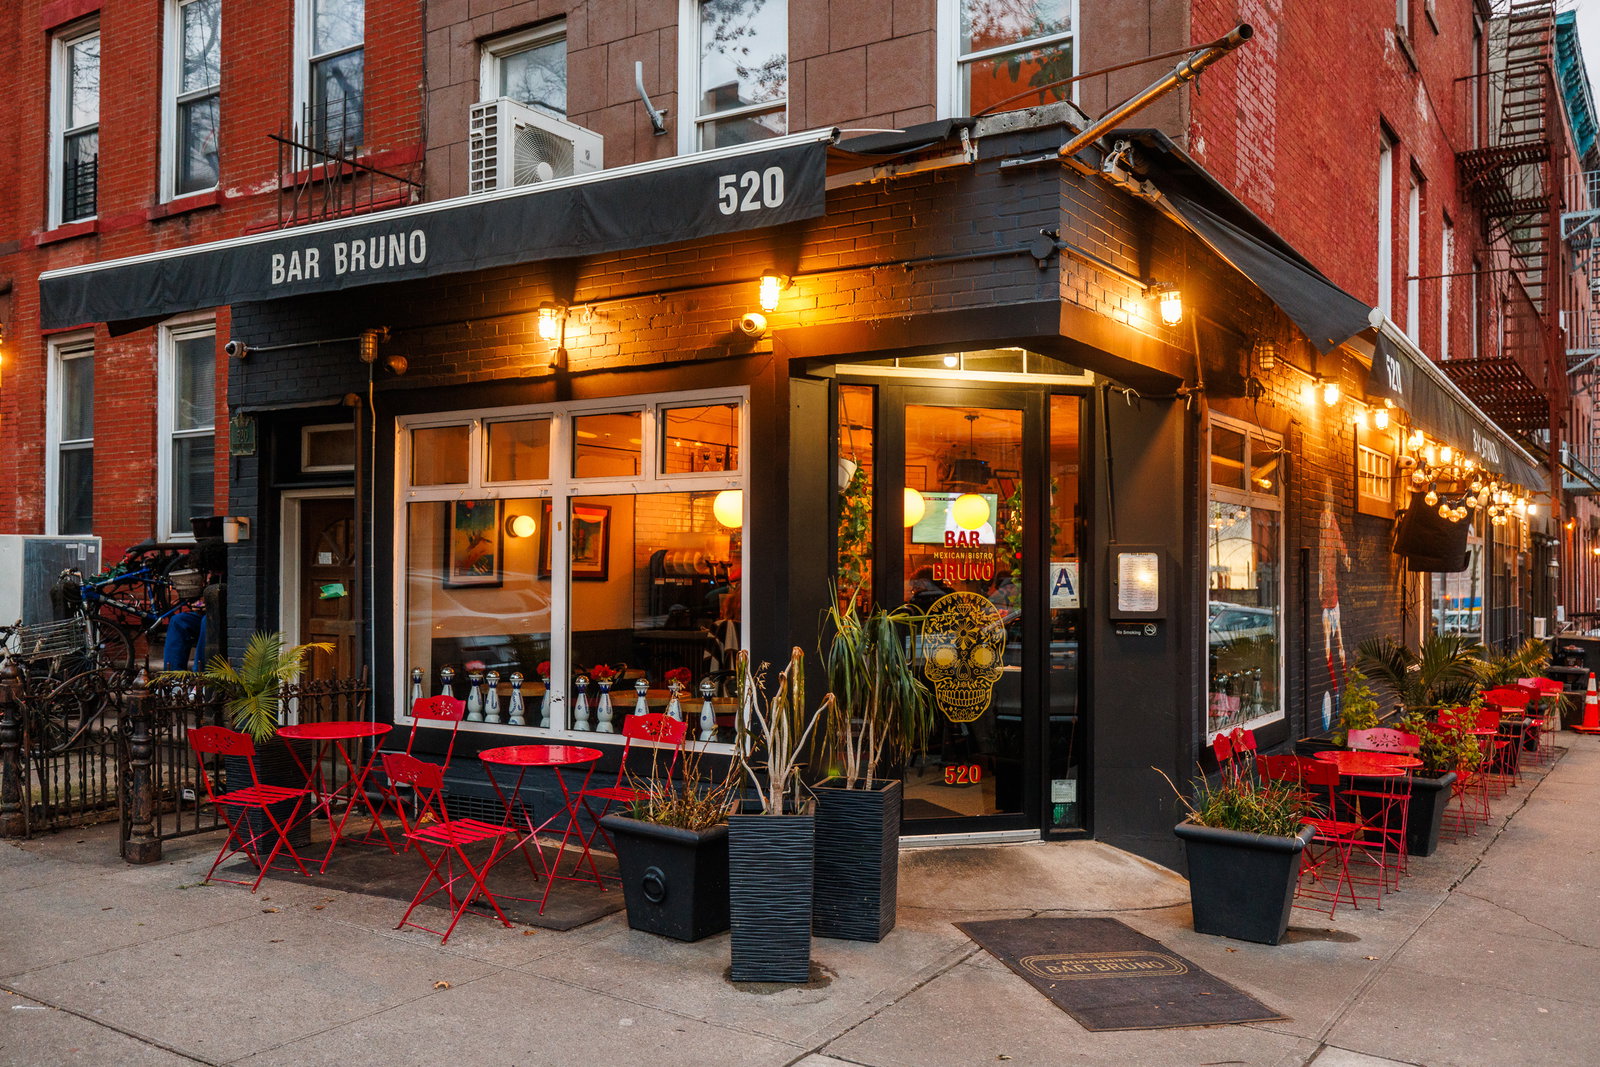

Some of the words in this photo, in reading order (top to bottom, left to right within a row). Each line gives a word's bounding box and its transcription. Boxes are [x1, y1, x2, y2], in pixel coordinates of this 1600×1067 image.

[718, 166, 784, 216] 520
[271, 247, 320, 285] BAR
[333, 229, 427, 275] BRUNO
[944, 530, 980, 549] BAR
[933, 551, 965, 559] MEXICAN
[967, 551, 993, 560] BISTRO
[932, 562, 995, 582] BRUNO
[1052, 568, 1075, 596] A
[944, 764, 982, 785] 520
[1046, 963, 1091, 974] BAR
[1094, 961, 1166, 972] BRUNO
